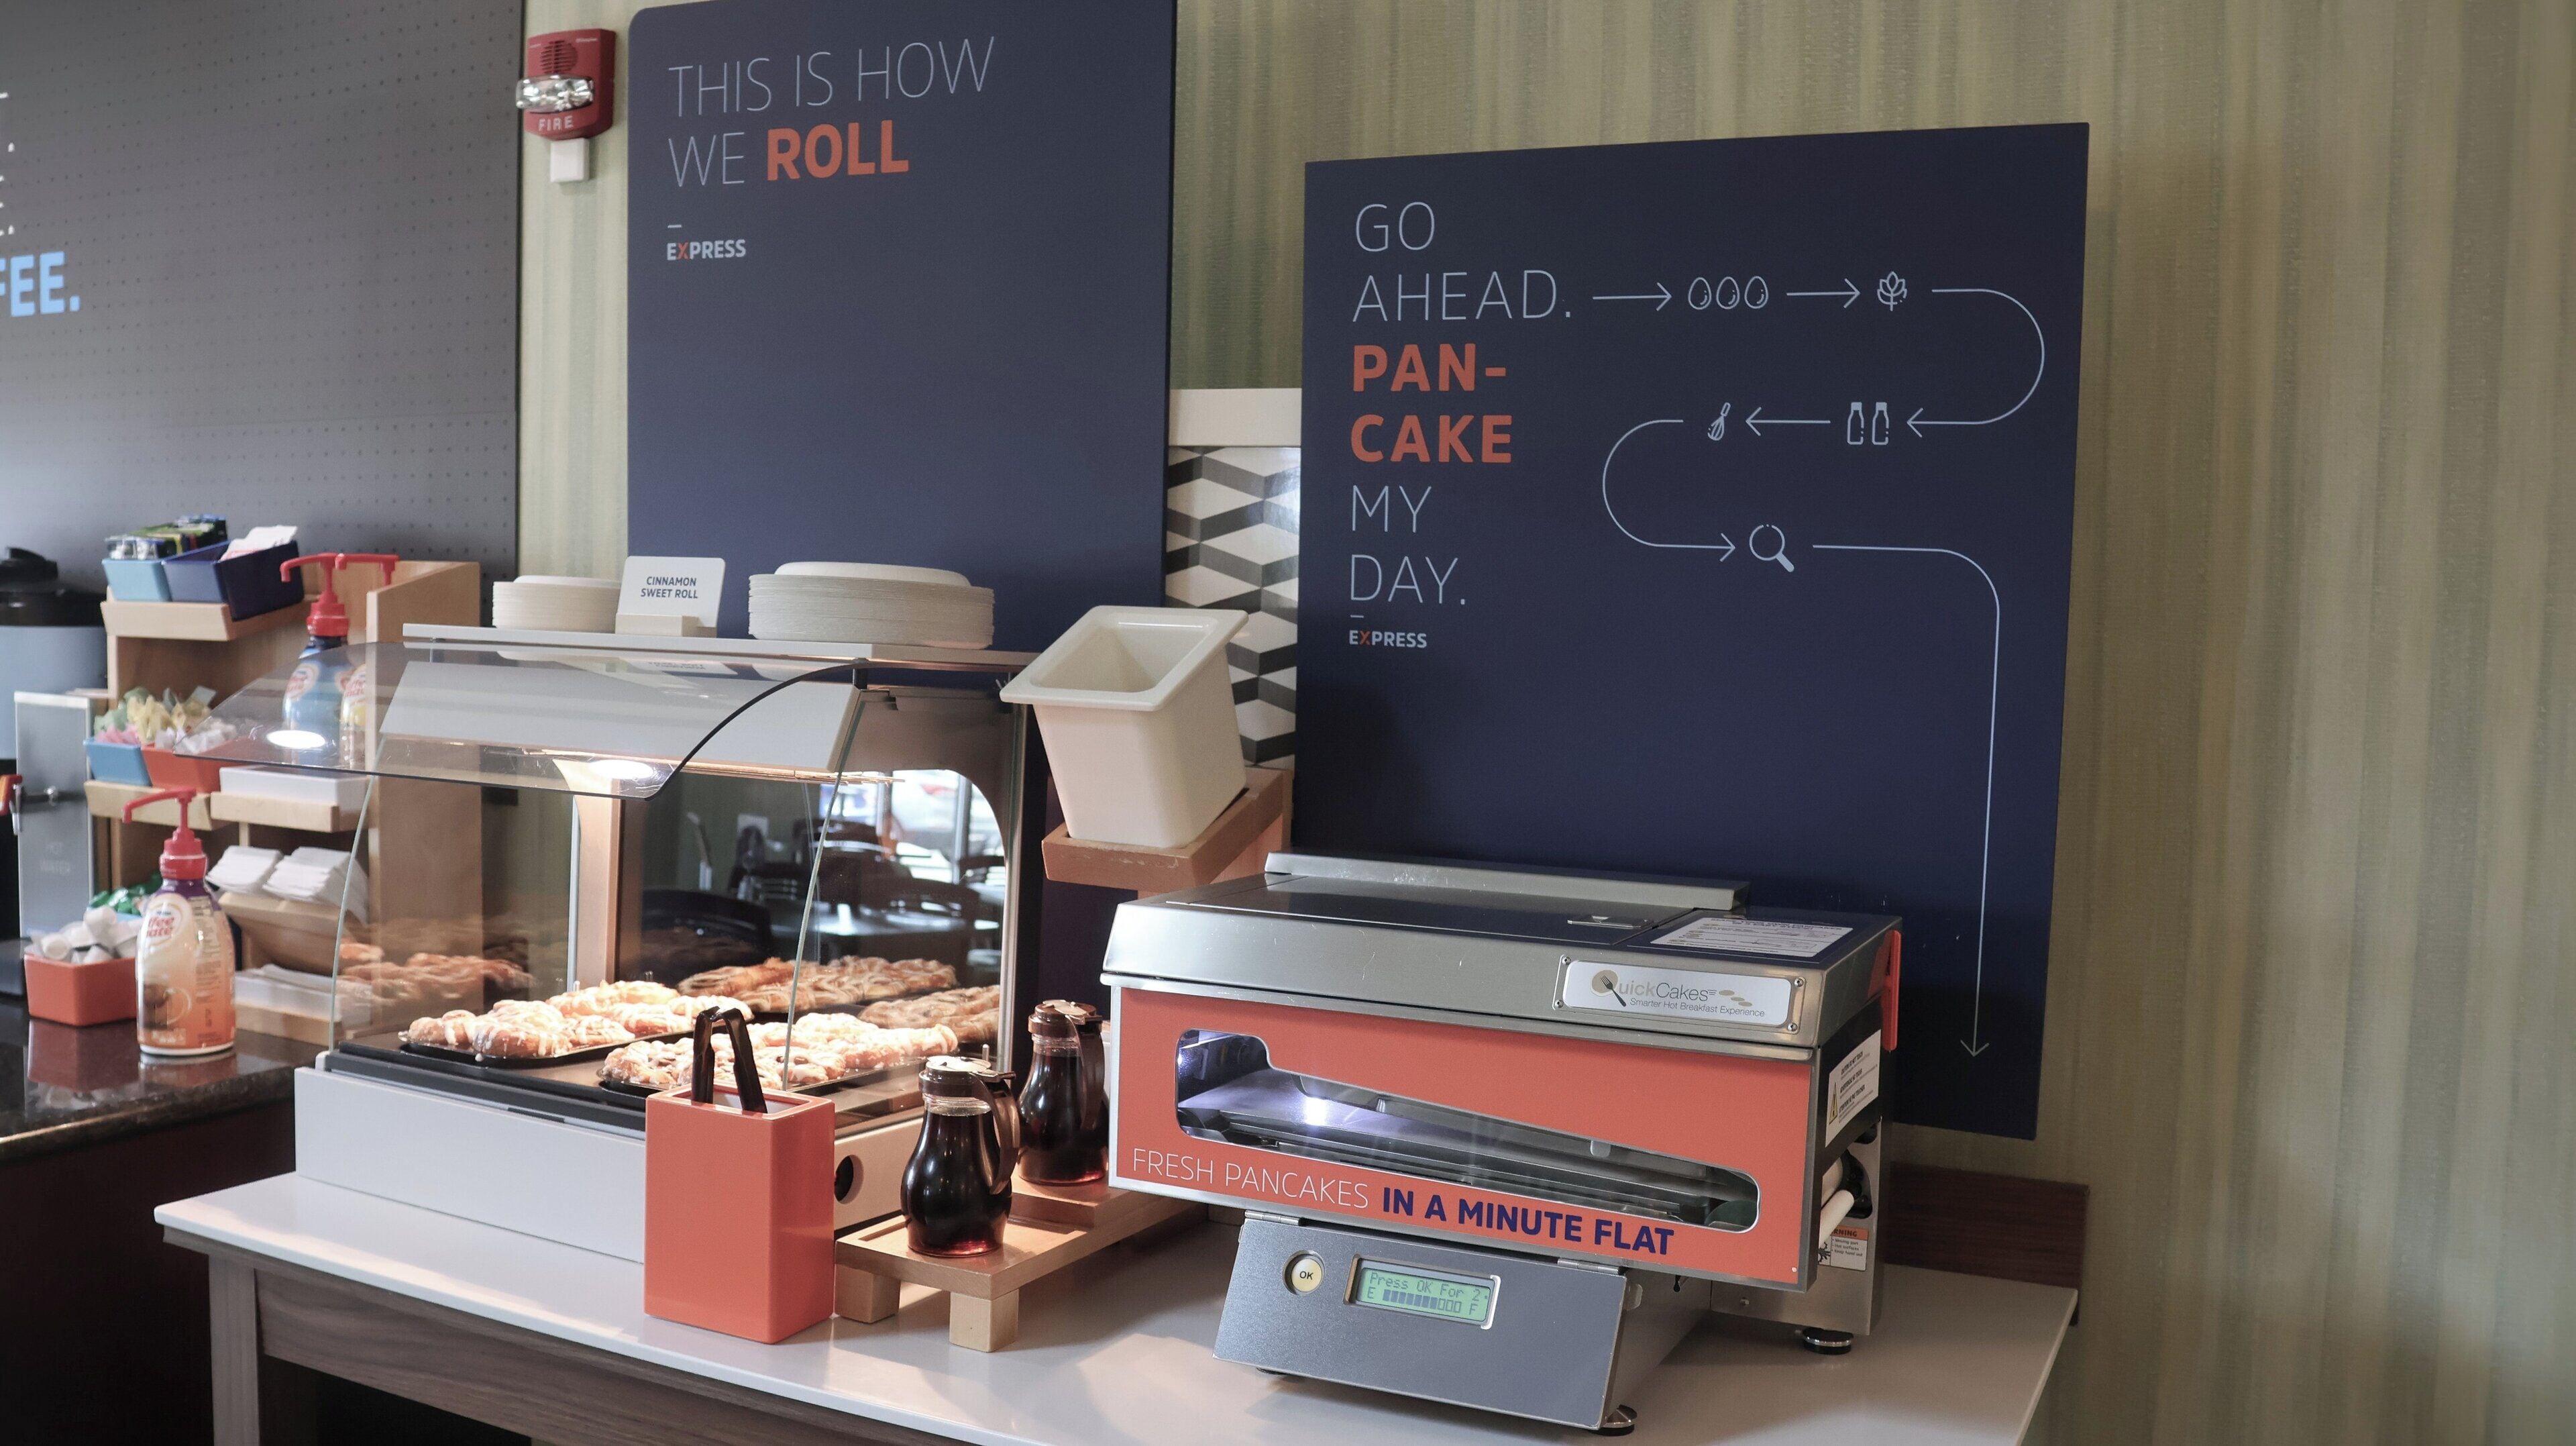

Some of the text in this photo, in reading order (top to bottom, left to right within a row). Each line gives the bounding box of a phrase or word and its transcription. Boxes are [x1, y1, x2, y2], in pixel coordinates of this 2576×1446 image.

[668, 36, 995, 117] THIS IS HOW
[538, 115, 574, 132] FIRE
[668, 119, 910, 187] WE ROLL
[1355, 201, 1436, 252] GO
[667, 239, 747, 261] EXPRESS
[1352, 269, 1571, 323] AHEAD.
[1352, 343, 1507, 392] PAN-
[1350, 413, 1513, 463] CAKE
[1352, 484, 1432, 533] MY
[641, 588, 698, 599] SWEET ROLL
[646, 576, 698, 587] CINNAMON
[1350, 554, 1466, 605] DAY.
[1348, 629, 1428, 649] EXPRESS
[1629, 998, 1766, 1018] Smarter Hot Breakfast Experience
[1133, 1147, 1675, 1255] FRESH PANCAKES IN A MINUTE FLAT
[1833, 1229, 1858, 1237] RNING
[1299, 1270, 1314, 1280] OK
[1369, 1272, 1409, 1290] Press
[1416, 1279, 1432, 1294] OK
[1439, 1284, 1464, 1299] For
[1366, 1288, 1479, 1316] E F
